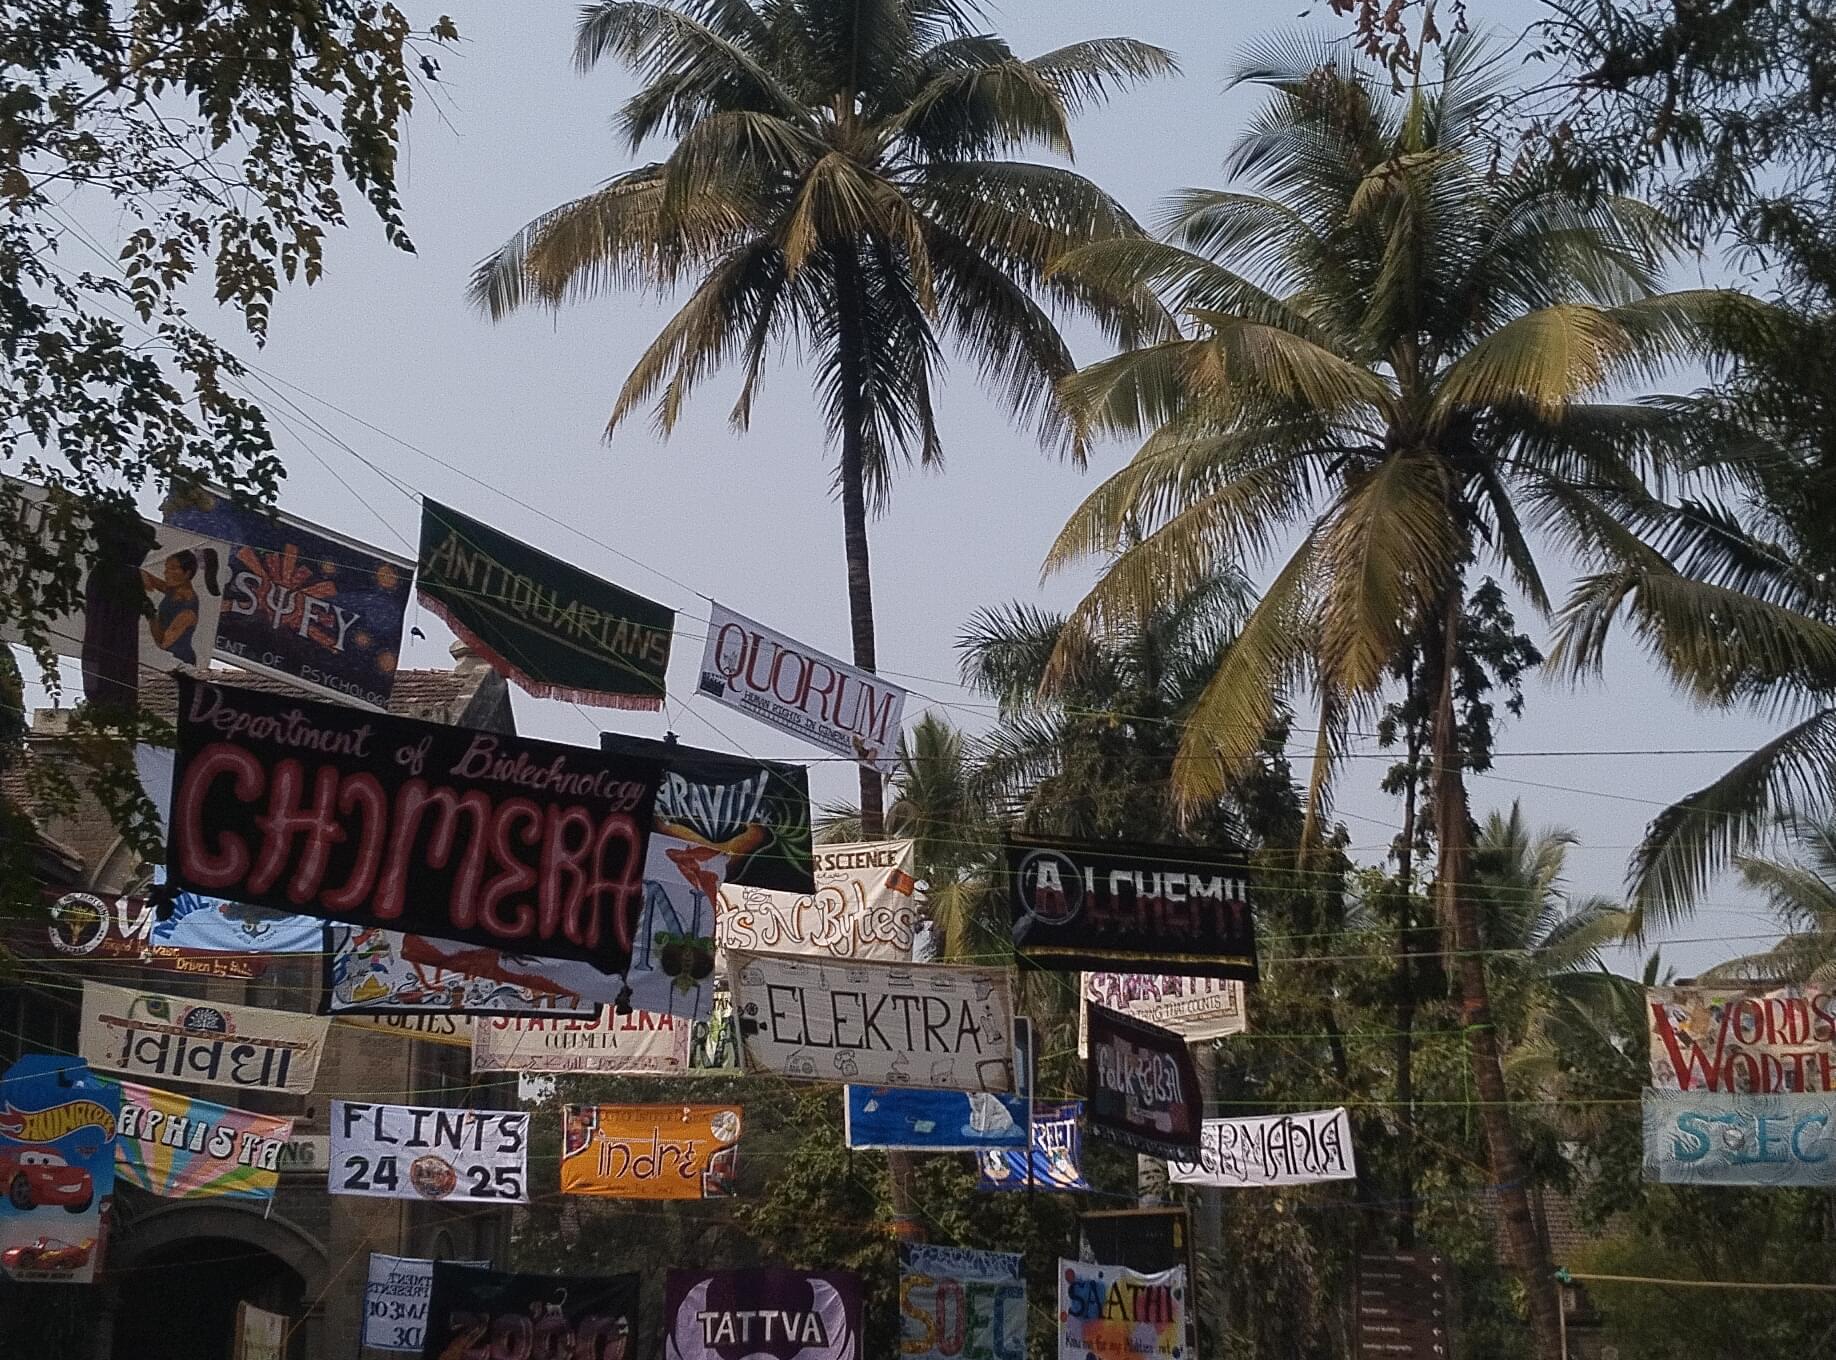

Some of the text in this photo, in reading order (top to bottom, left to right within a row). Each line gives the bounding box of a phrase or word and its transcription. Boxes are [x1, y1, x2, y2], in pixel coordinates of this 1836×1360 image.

[423, 530, 667, 666] ANTIQUARIANS
[262, 651, 284, 667] OF
[715, 623, 896, 745] QUORUM
[189, 683, 646, 810] Department of Biotechnology
[827, 850, 898, 871] SCIENCE
[810, 881, 915, 958] Bytes
[766, 983, 982, 1054] ELEKTRA
[117, 1102, 284, 1172] APHISTA
[343, 1101, 523, 1154] FLINTS
[343, 1155, 399, 1192] 24
[466, 1163, 523, 1200] 25
[698, 1309, 822, 1344] TATTVA
[1067, 1280, 1175, 1323] SAATHI
